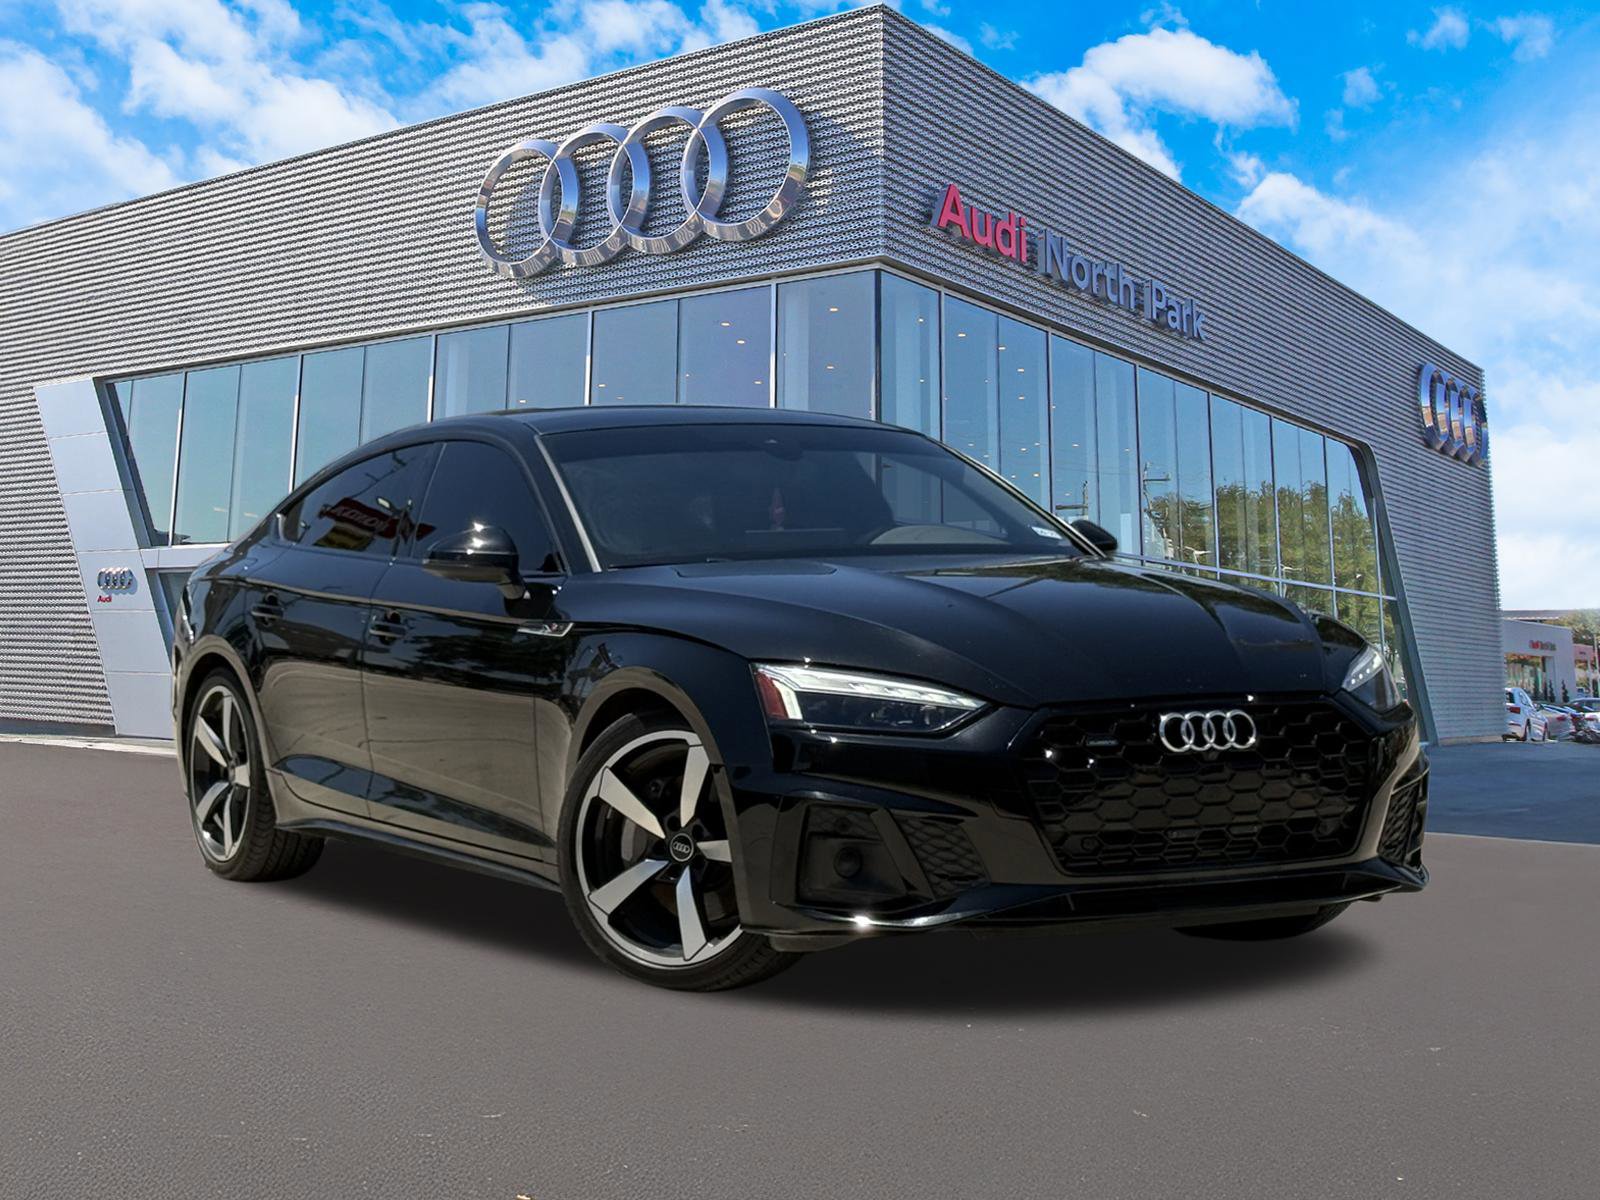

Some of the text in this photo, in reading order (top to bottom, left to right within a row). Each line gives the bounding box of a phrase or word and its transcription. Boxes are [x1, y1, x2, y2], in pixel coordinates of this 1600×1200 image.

[932, 183, 1207, 341] Audi North Park
